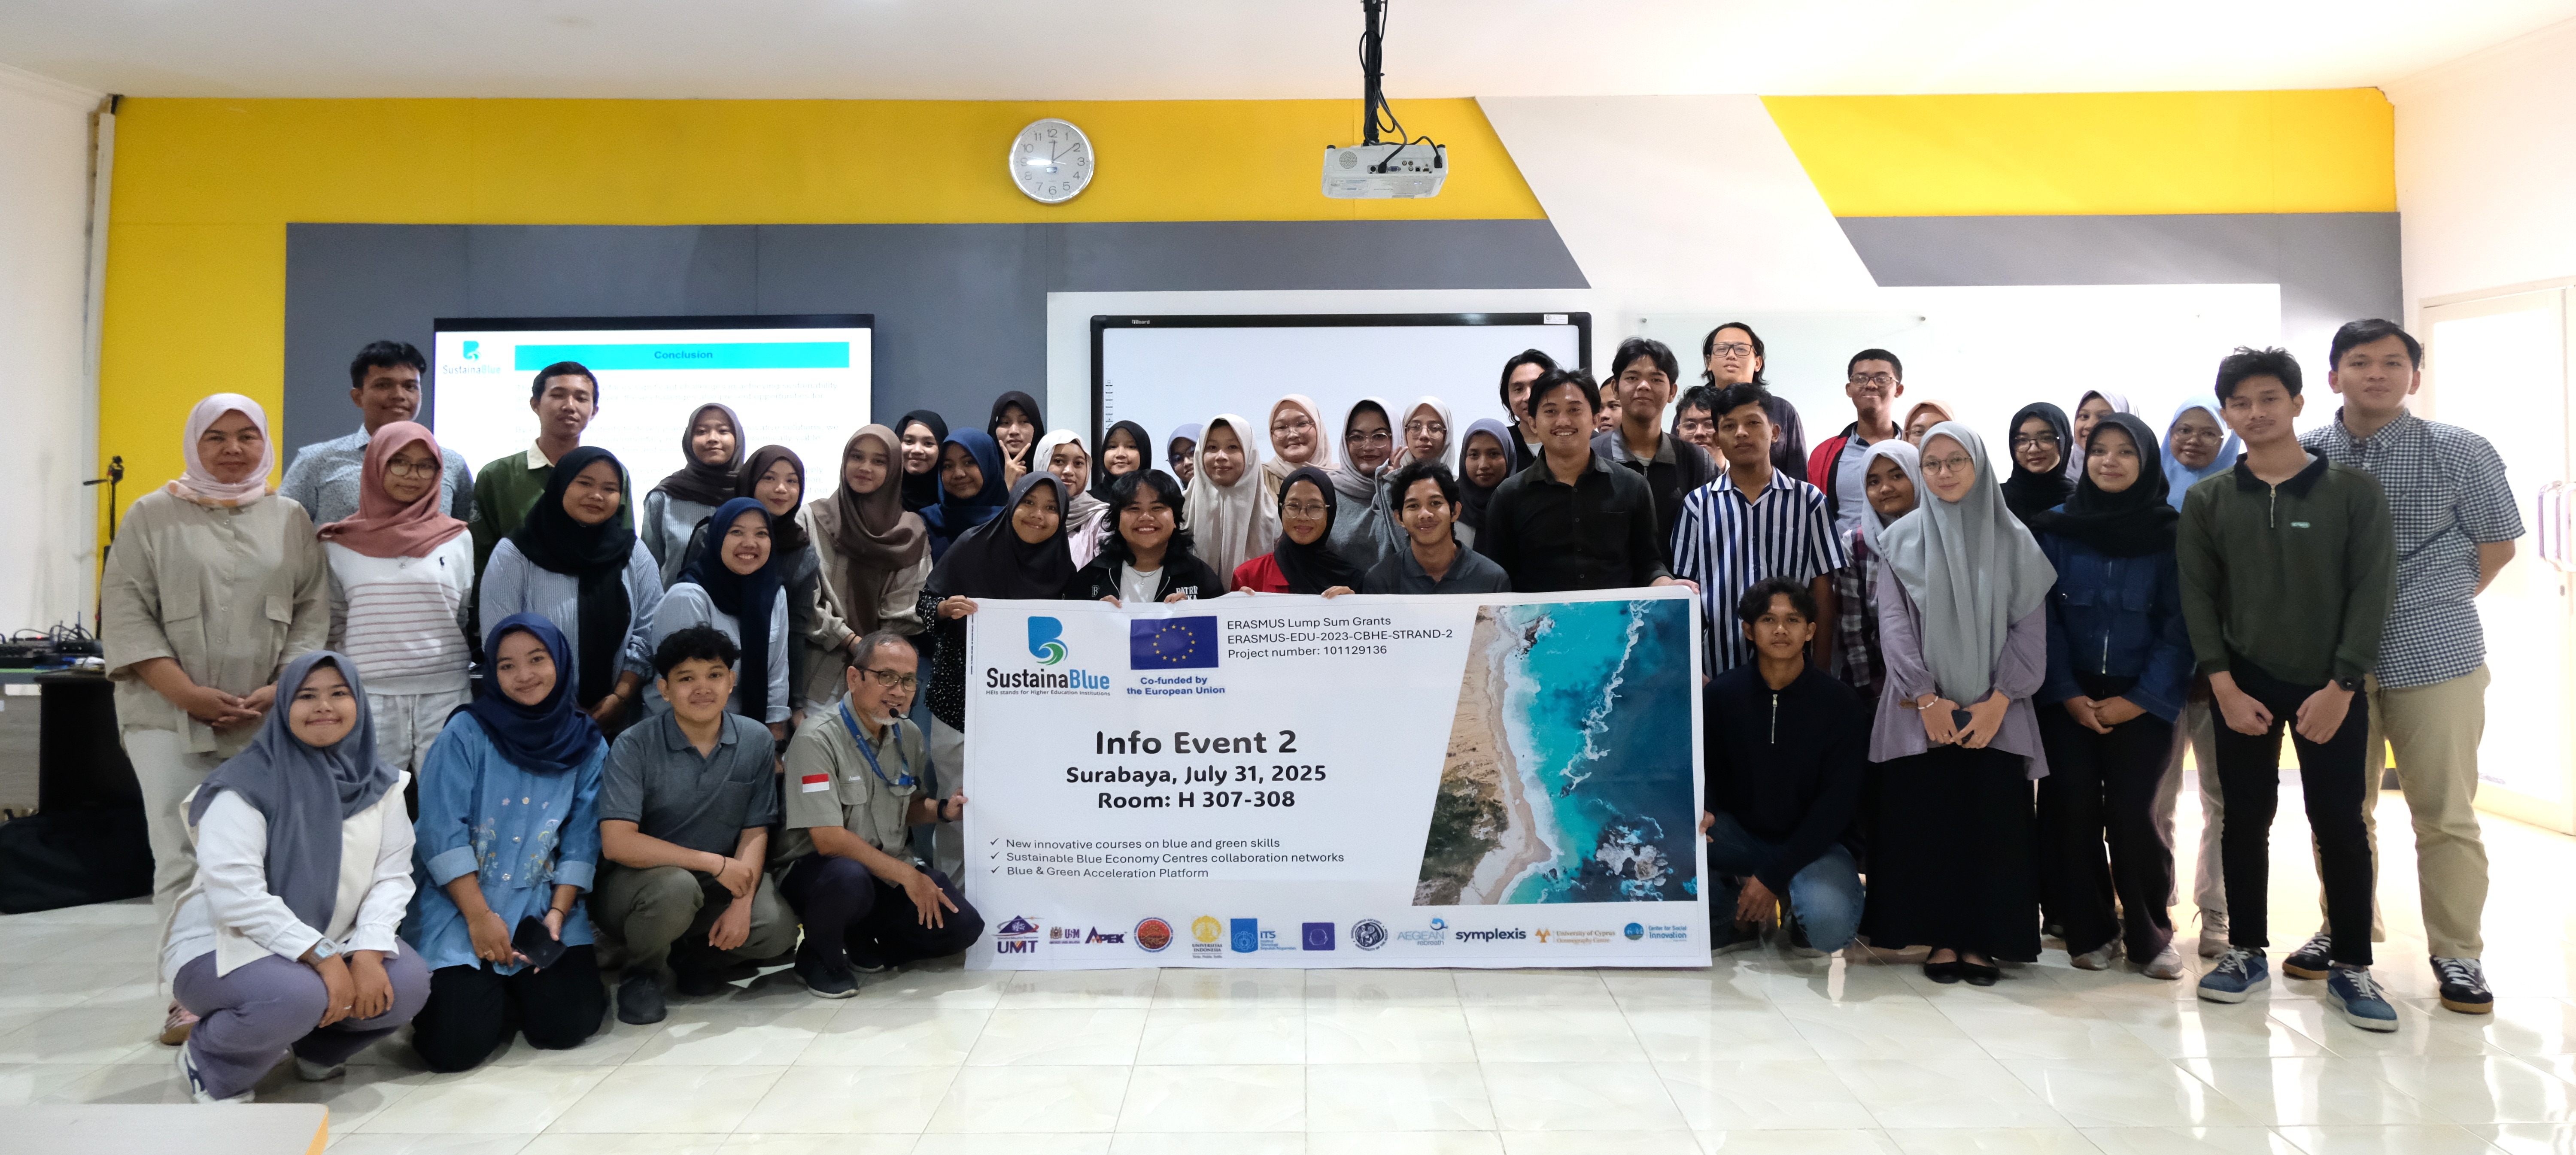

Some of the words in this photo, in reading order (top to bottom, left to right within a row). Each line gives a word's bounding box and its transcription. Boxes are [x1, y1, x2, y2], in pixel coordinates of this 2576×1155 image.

[1047, 129, 1057, 138] 12
[1066, 133, 1068, 141] 1
[1024, 144, 1033, 152] 10
[1073, 142, 1081, 152] 2
[1020, 158, 1027, 166] 9
[1077, 157, 1085, 166] 3
[1024, 172, 1032, 180] 8
[1036, 182, 1043, 191] 7
[1049, 186, 1057, 195] 6
[1063, 182, 1070, 191] 5
[654, 350, 713, 360] Conclusion
[443, 365, 501, 374] SustainaBlue
[782, 382, 837, 390] sustainability
[754, 392, 809, 400] opportunities
[1092, 585, 1099, 597] B
[1228, 619, 1285, 629] ERASMUS
[1288, 619, 1319, 628] Lump
[1324, 618, 1349, 626] Sum
[1353, 617, 1391, 626] Grants
[1228, 630, 1452, 644] ERASMUS-EDU-2023-CBHE-STRAND-2
[1229, 649, 1268, 659] Project
[1272, 647, 1319, 657] number:
[1324, 646, 1387, 655] 101129136
[987, 668, 1110, 689] SustainaBlue
[1196, 676, 1207, 685] by
[1145, 688, 1193, 696] European
[1097, 731, 1161, 754] Info
[1175, 732, 1267, 754] Event
[1279, 730, 1297, 753] 2
[1067, 766, 1176, 787] Surabaya,
[1185, 765, 1227, 786] July
[1235, 766, 1263, 784] 31,
[1272, 765, 1326, 781] 2025
[1099, 793, 1170, 808] Room:
[1179, 792, 1194, 807] H
[1203, 791, 1294, 807] 307-308
[1006, 840, 1031, 848] New
[1035, 840, 1092, 849] innovative
[1163, 840, 1187, 848] blue
[1191, 839, 1212, 848] and
[1216, 840, 1247, 850] green
[1251, 839, 1279, 847] skills
[1007, 853, 1073, 863] Sustainable
[1077, 855, 1102, 863] Blue
[1106, 855, 1159, 865] Economy
[1163, 854, 1207, 863] Centres
[1212, 853, 1288, 862] collaboration
[1292, 853, 1344, 862] networks
[1047, 867, 1080, 876] Green
[1084, 869, 1155, 878] Acceleration
[1160, 869, 1208, 877] Platform
[1085, 926, 1124, 944] APEX
[1397, 931, 1444, 940] AEGEAN
[1455, 928, 1526, 943] symplexis
[997, 940, 1038, 954] UMT
